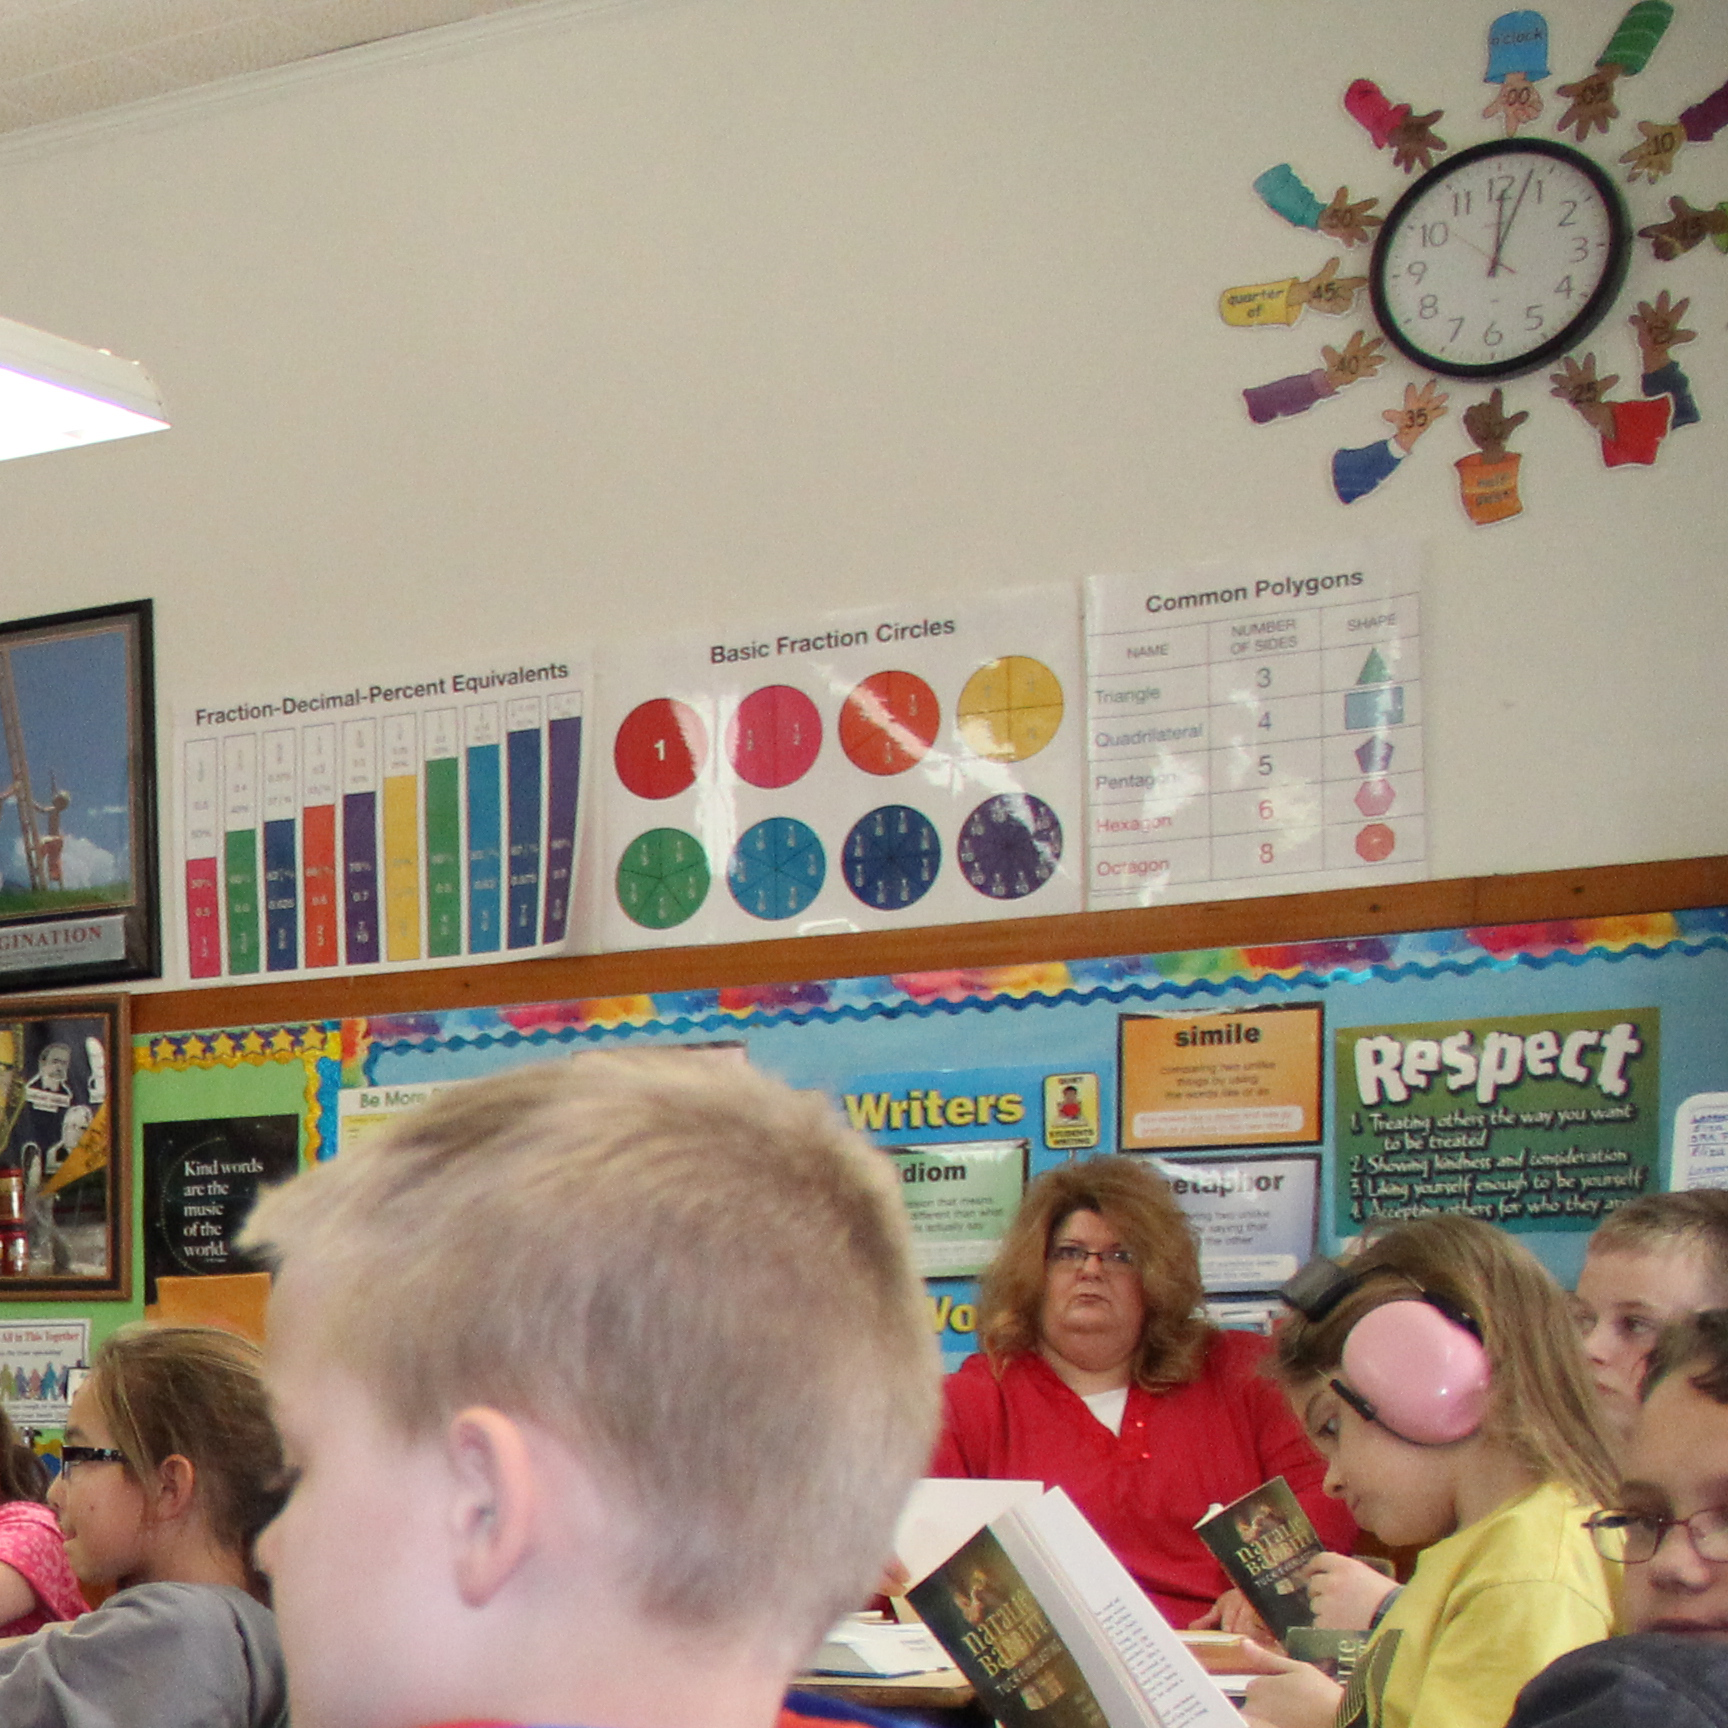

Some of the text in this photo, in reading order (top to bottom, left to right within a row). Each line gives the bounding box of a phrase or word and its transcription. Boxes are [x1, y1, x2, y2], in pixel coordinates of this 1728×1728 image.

[1557, 200, 1578, 227] 2
[1421, 222, 1449, 248] 10
[1569, 236, 1589, 263] 3
[1407, 261, 1427, 286] 9
[1553, 274, 1574, 300] 4
[1419, 294, 1439, 320] 8
[1525, 304, 1544, 332] 5
[1447, 317, 1466, 343] 7
[1483, 320, 1503, 346] 6
[1145, 570, 1365, 614] Common Polygons
[1230, 618, 1297, 637] NUMBER
[1346, 612, 1398, 632] SHAPE
[710, 619, 956, 665] Basic Fraction Circles
[1126, 643, 1170, 659] NAME
[1230, 636, 1298, 655] OF SIDES
[195, 663, 570, 727] Fraction-Decimal-Percent Equivalents
[1095, 666, 1273, 706] Triangle 3
[1094, 711, 1273, 748] Quadrilateral 4
[1257, 755, 1274, 777] 5
[1096, 799, 1275, 834] Hexagon 6
[1096, 842, 1275, 877] Octagon 8
[1175, 1023, 1262, 1048] simile
[1354, 1022, 1644, 1107] Respect
[359, 1092, 381, 1109] Be
[844, 1089, 1026, 1132] Writers
[1369, 1103, 1634, 1136] Treating others the way you want
[1384, 1129, 1489, 1151] to be treated
[183, 1157, 265, 1178] Kind words
[897, 1162, 967, 1183] diom
[1367, 1155, 1431, 1179] Showing
[1434, 1150, 1493, 1172] kindness
[183, 1181, 230, 1198] are the
[183, 1200, 226, 1217] music
[183, 1221, 223, 1237] of the
[183, 1241, 229, 1258] world.
